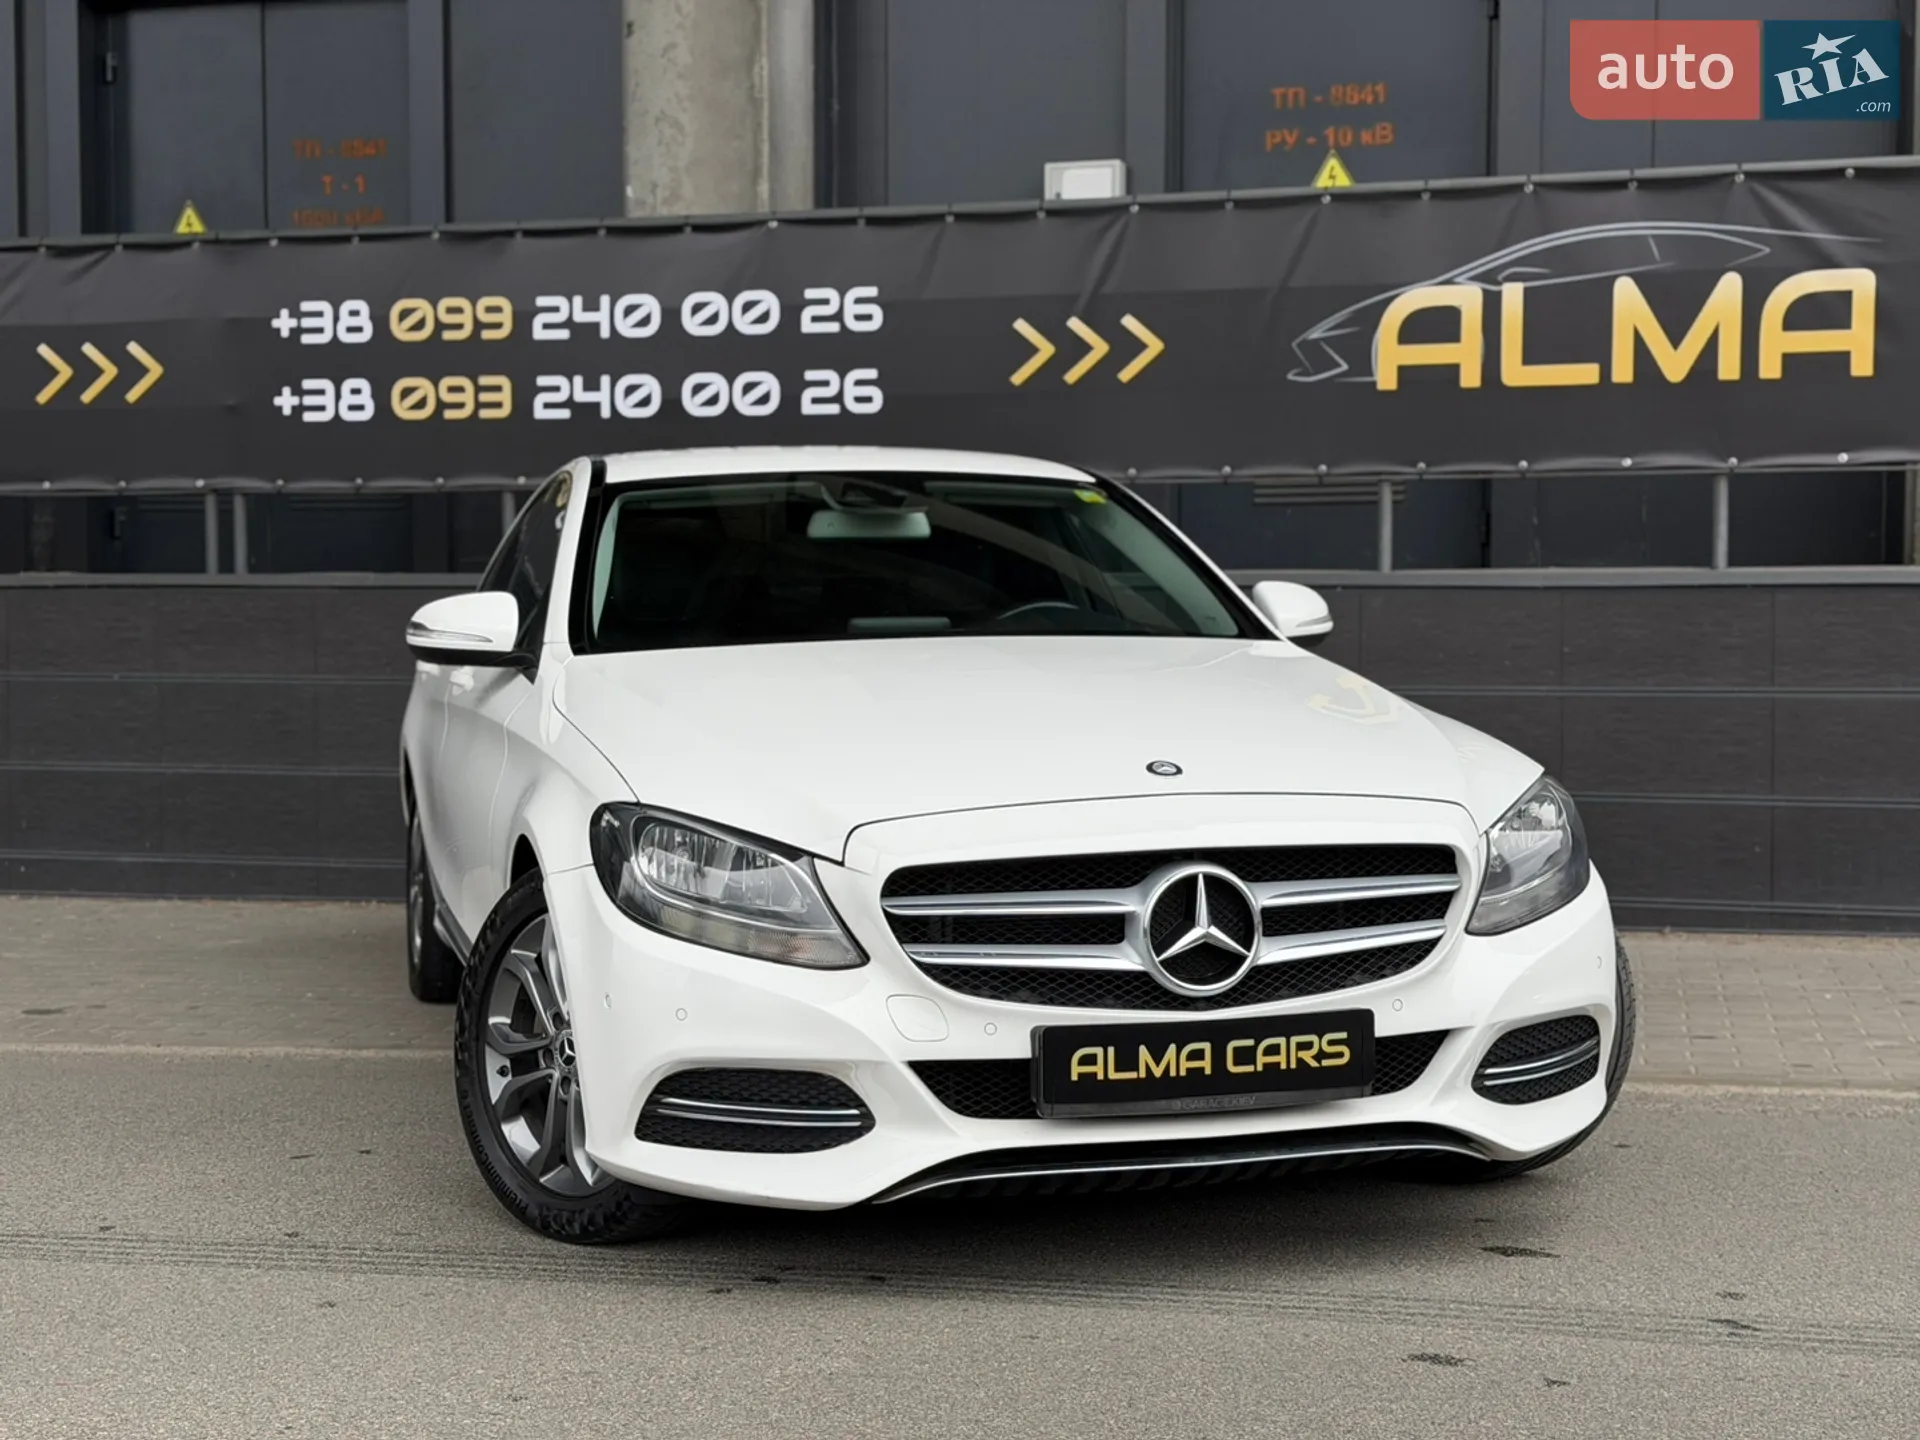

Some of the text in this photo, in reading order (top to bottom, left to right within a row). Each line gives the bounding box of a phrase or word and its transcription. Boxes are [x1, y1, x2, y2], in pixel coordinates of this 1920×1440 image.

[1270, 86, 1307, 110] ТП
[1265, 127, 1300, 152] РУ
[1323, 125, 1354, 149] 10
[270, 285, 884, 345] +38 099 240 00 26
[1375, 267, 1878, 393] ALMA
[272, 367, 884, 423] +38 093 240 00 26
[1070, 1031, 1351, 1081] ALMA CARS
